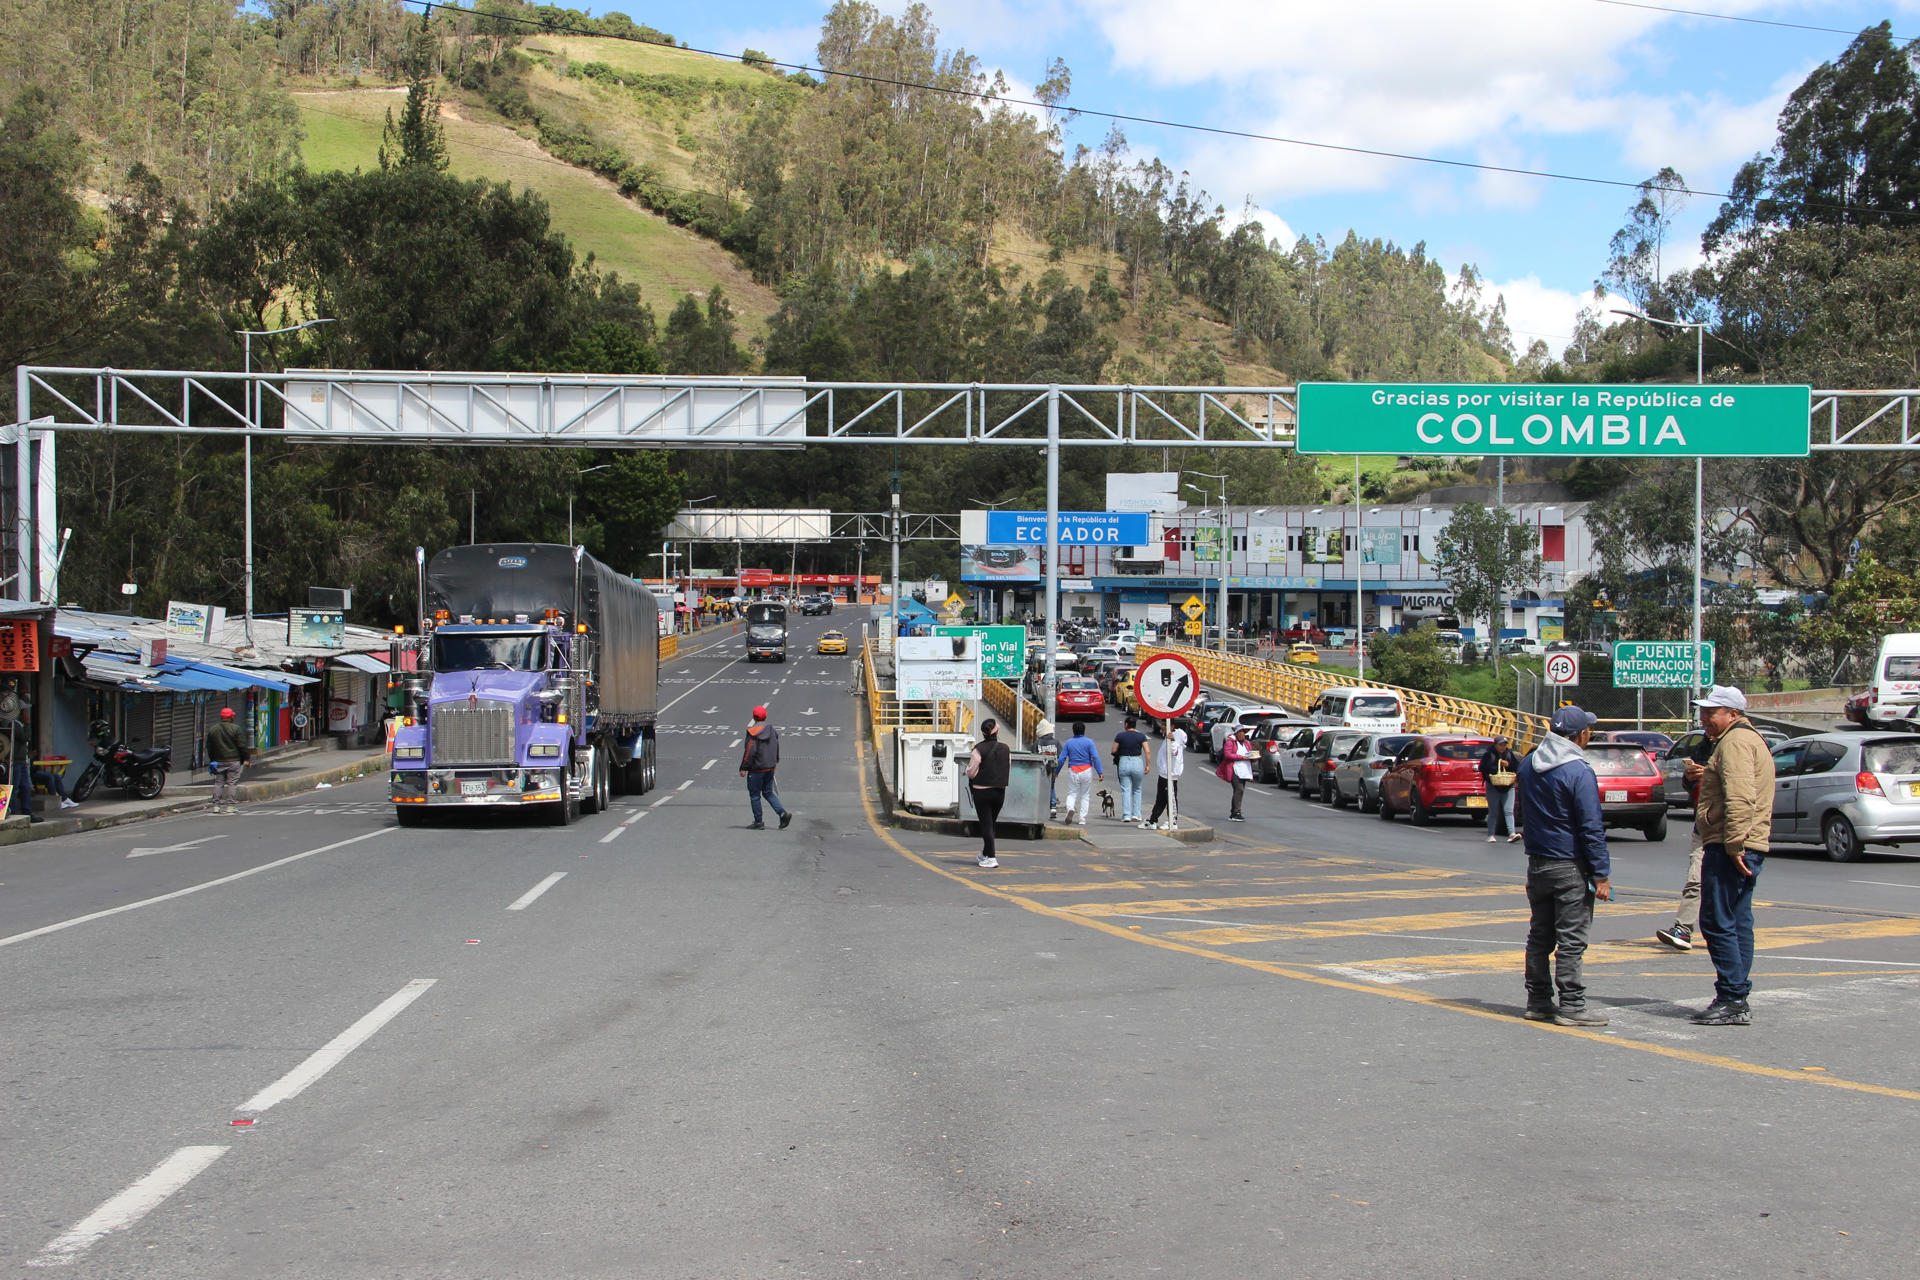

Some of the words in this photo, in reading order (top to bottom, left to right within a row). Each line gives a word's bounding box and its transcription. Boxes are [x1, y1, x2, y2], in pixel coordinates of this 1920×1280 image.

[1372, 389, 1450, 406] Gracias
[1457, 394, 1492, 409] por
[1499, 391, 1564, 407] visitar
[1572, 391, 1590, 407] la
[1597, 391, 1702, 411] República
[1709, 392, 1735, 407] de
[1416, 413, 1687, 446] COLOMBIA
[1017, 515, 1048, 523] Bienveni
[1072, 515, 1107, 525] República
[1016, 527, 1119, 542] ECADOR
[1244, 577, 1303, 586] CENAF
[1401, 595, 1457, 608] MIGRACI
[1186, 622, 1200, 631] 40
[0, 621, 16, 663] MNUTOS
[999, 642, 1018, 651] Vial
[1635, 645, 1692, 658] PUENTE
[980, 653, 995, 663] Del
[997, 653, 1014, 663] Sur
[1551, 662, 1569, 674] 48
[1619, 659, 1709, 671] INTERNACIONL
